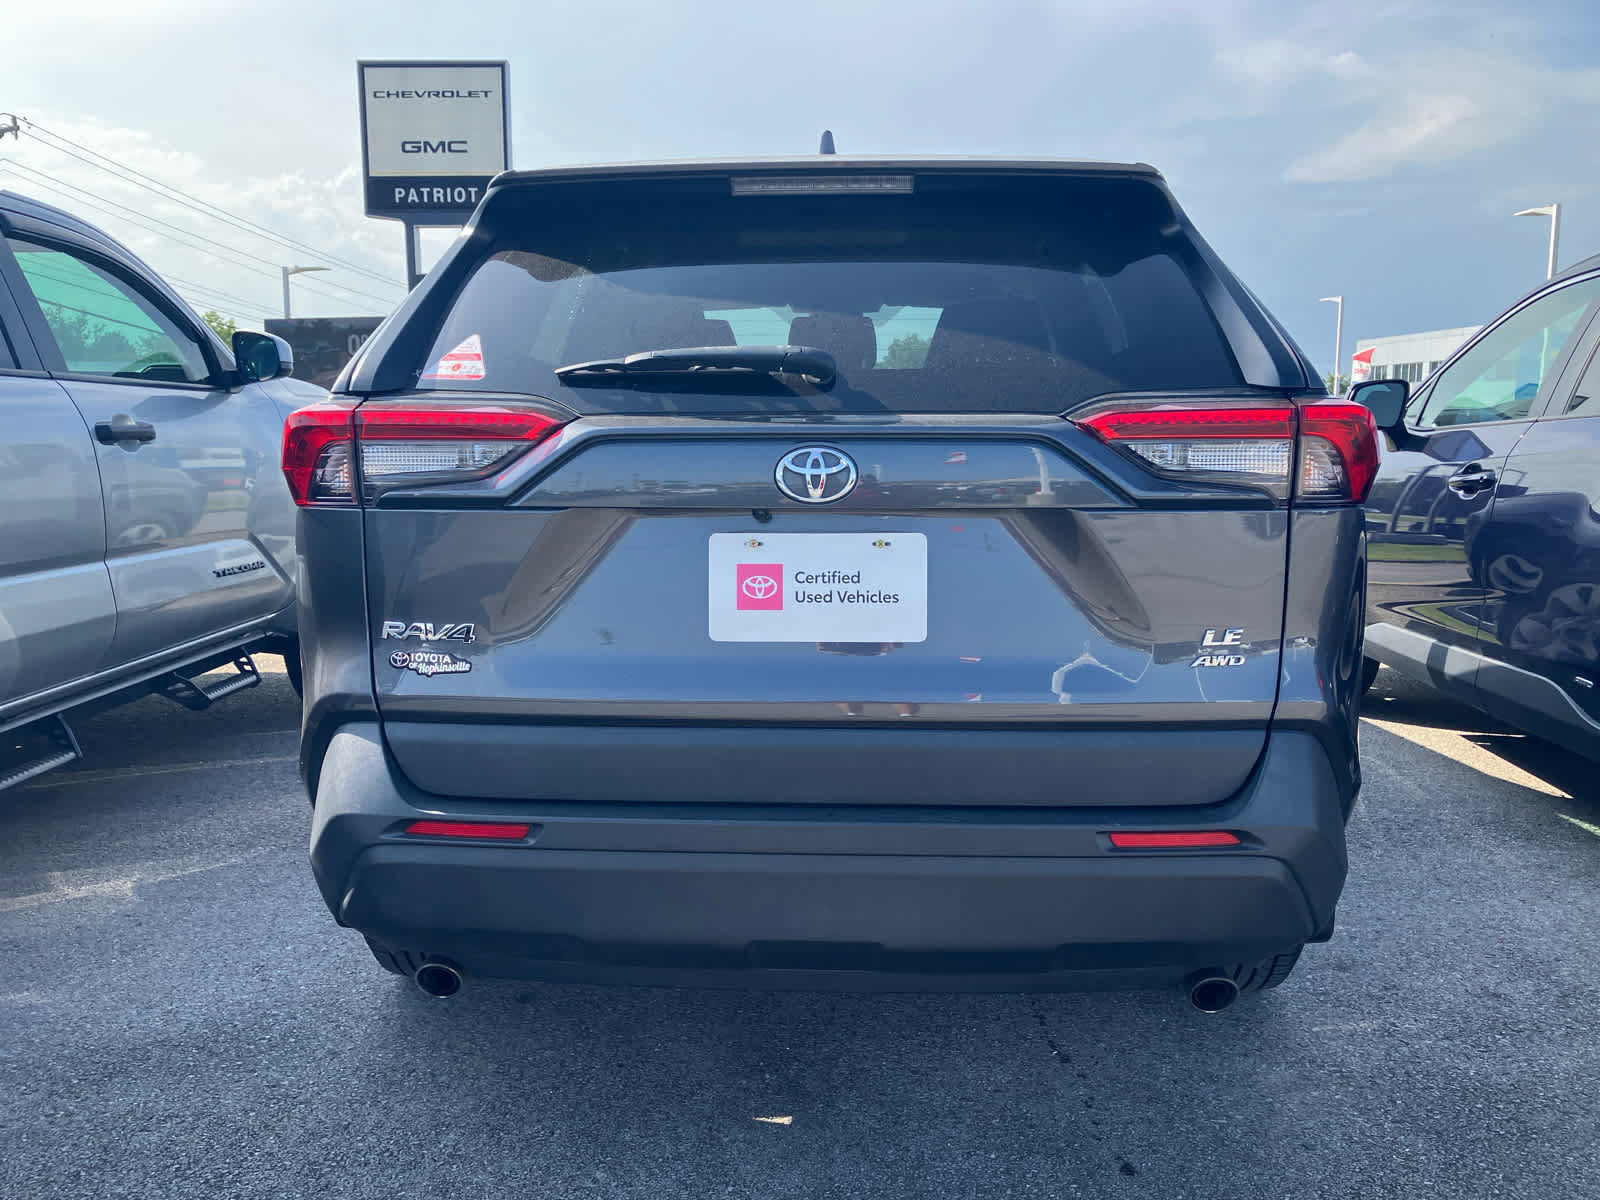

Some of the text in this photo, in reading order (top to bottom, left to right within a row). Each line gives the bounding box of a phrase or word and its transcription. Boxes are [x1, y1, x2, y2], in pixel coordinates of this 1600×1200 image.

[373, 90, 492, 99] CHEVROLET
[401, 140, 468, 154] GMC
[394, 187, 479, 203] PATRIOT
[794, 570, 861, 584] Certified
[795, 590, 900, 604] Used Vehicles
[382, 620, 476, 644] RAV4
[1202, 628, 1244, 647] LE
[410, 652, 451, 664] TOYOTA
[1190, 655, 1246, 668] AWD
[418, 661, 471, 676] Hopkinsville
